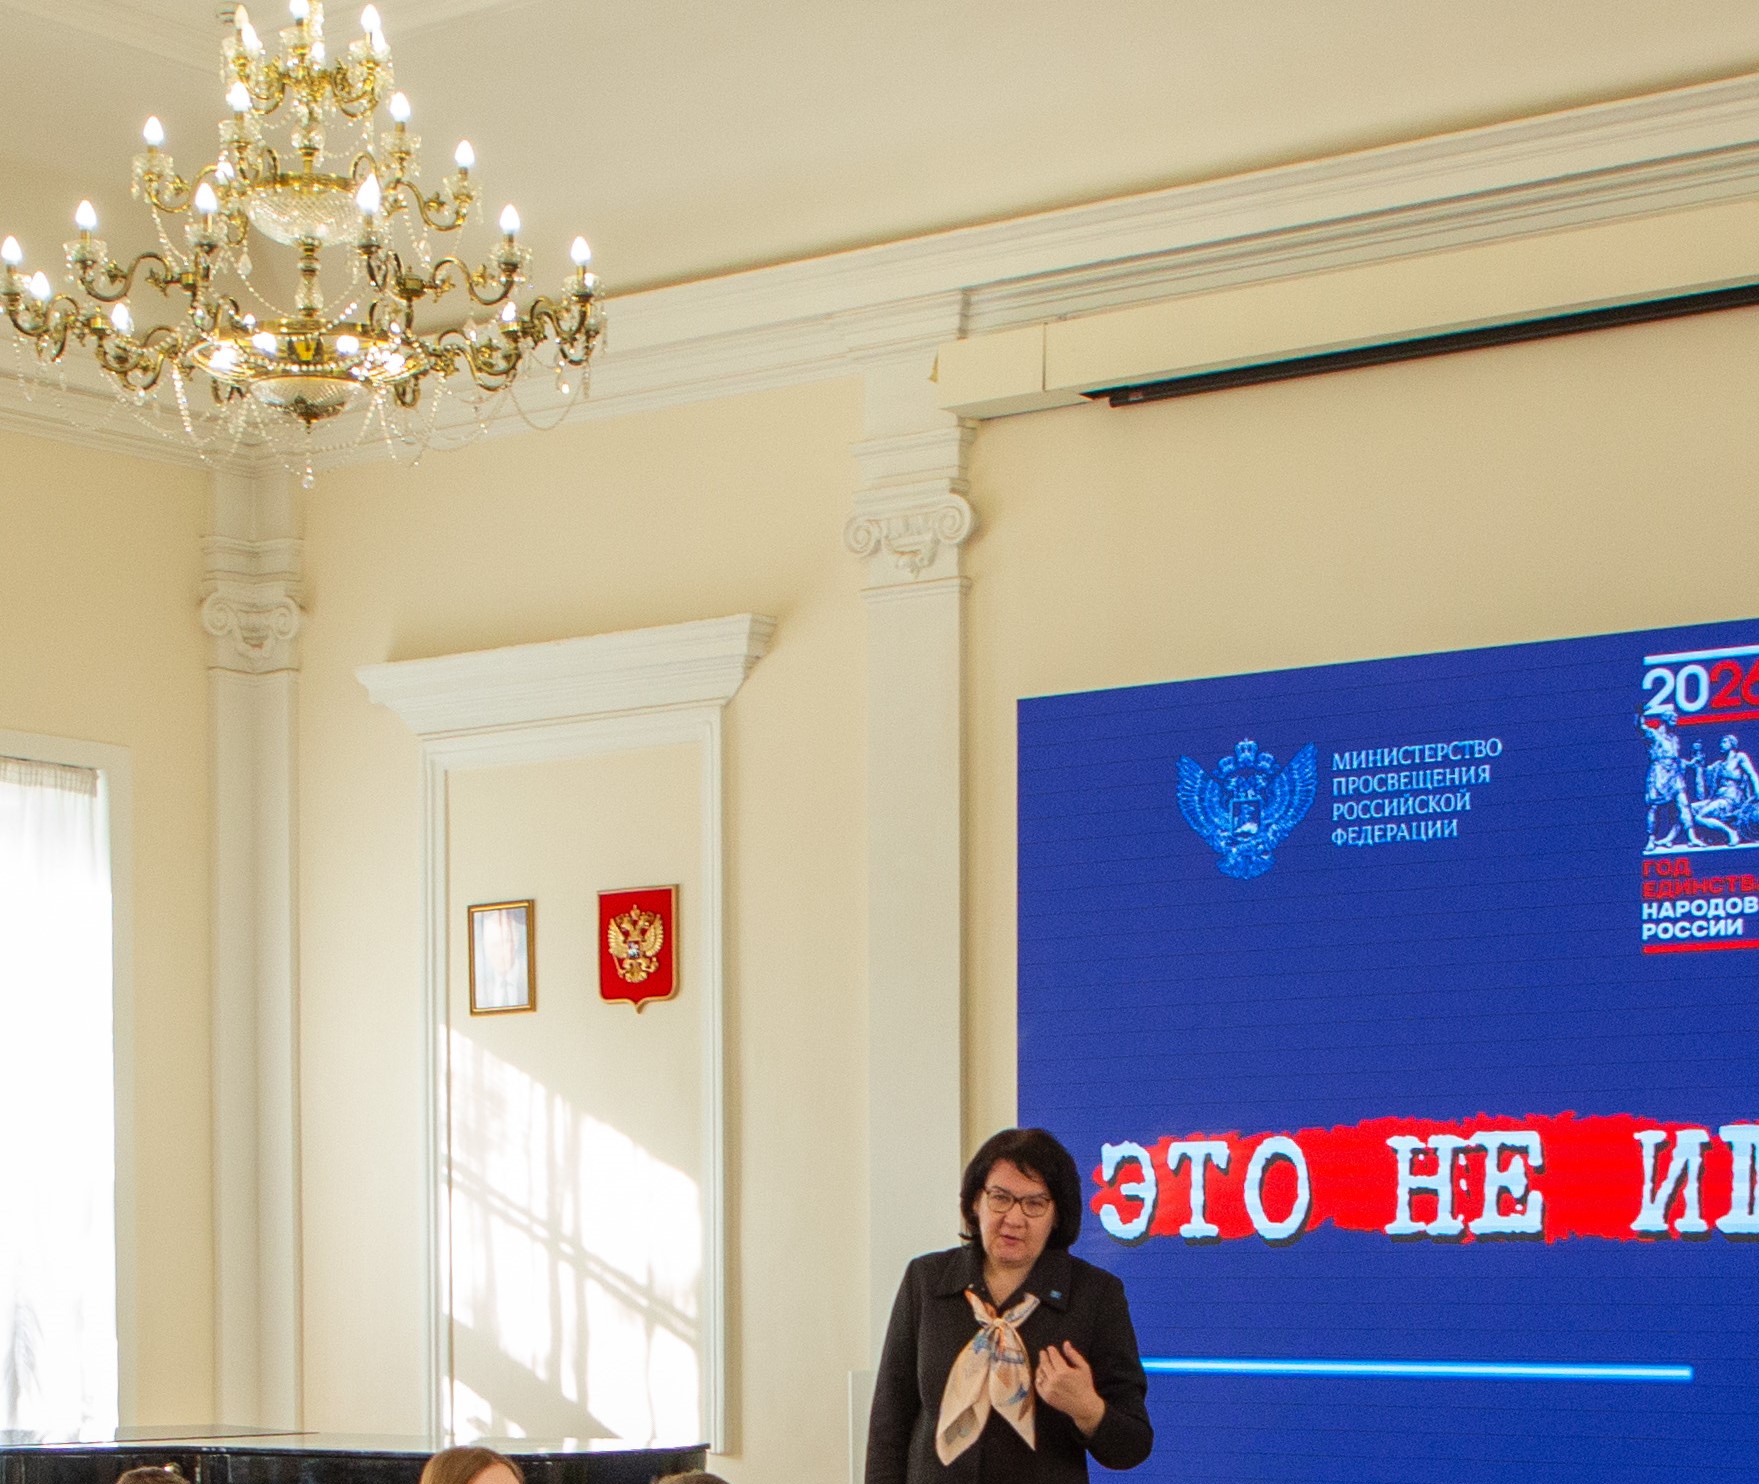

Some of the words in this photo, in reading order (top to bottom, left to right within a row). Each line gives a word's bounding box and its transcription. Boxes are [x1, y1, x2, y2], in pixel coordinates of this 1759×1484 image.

[1331, 738, 1503, 770] МИНИСТЕРСТВО
[1332, 765, 1491, 796] ПРОСВЕЩЕНИЯ
[1332, 788, 1472, 821] РОССИЙСКОЙ
[1331, 819, 1458, 847] ФЕДЕРАЦИИ
[1642, 858, 1691, 878] ГОД
[1642, 896, 1759, 920] НАРОДОВ
[1642, 918, 1743, 941] РОССИИ
[1100, 1136, 1311, 1241] ЭТО
[1385, 1130, 1544, 1239] НЕ
